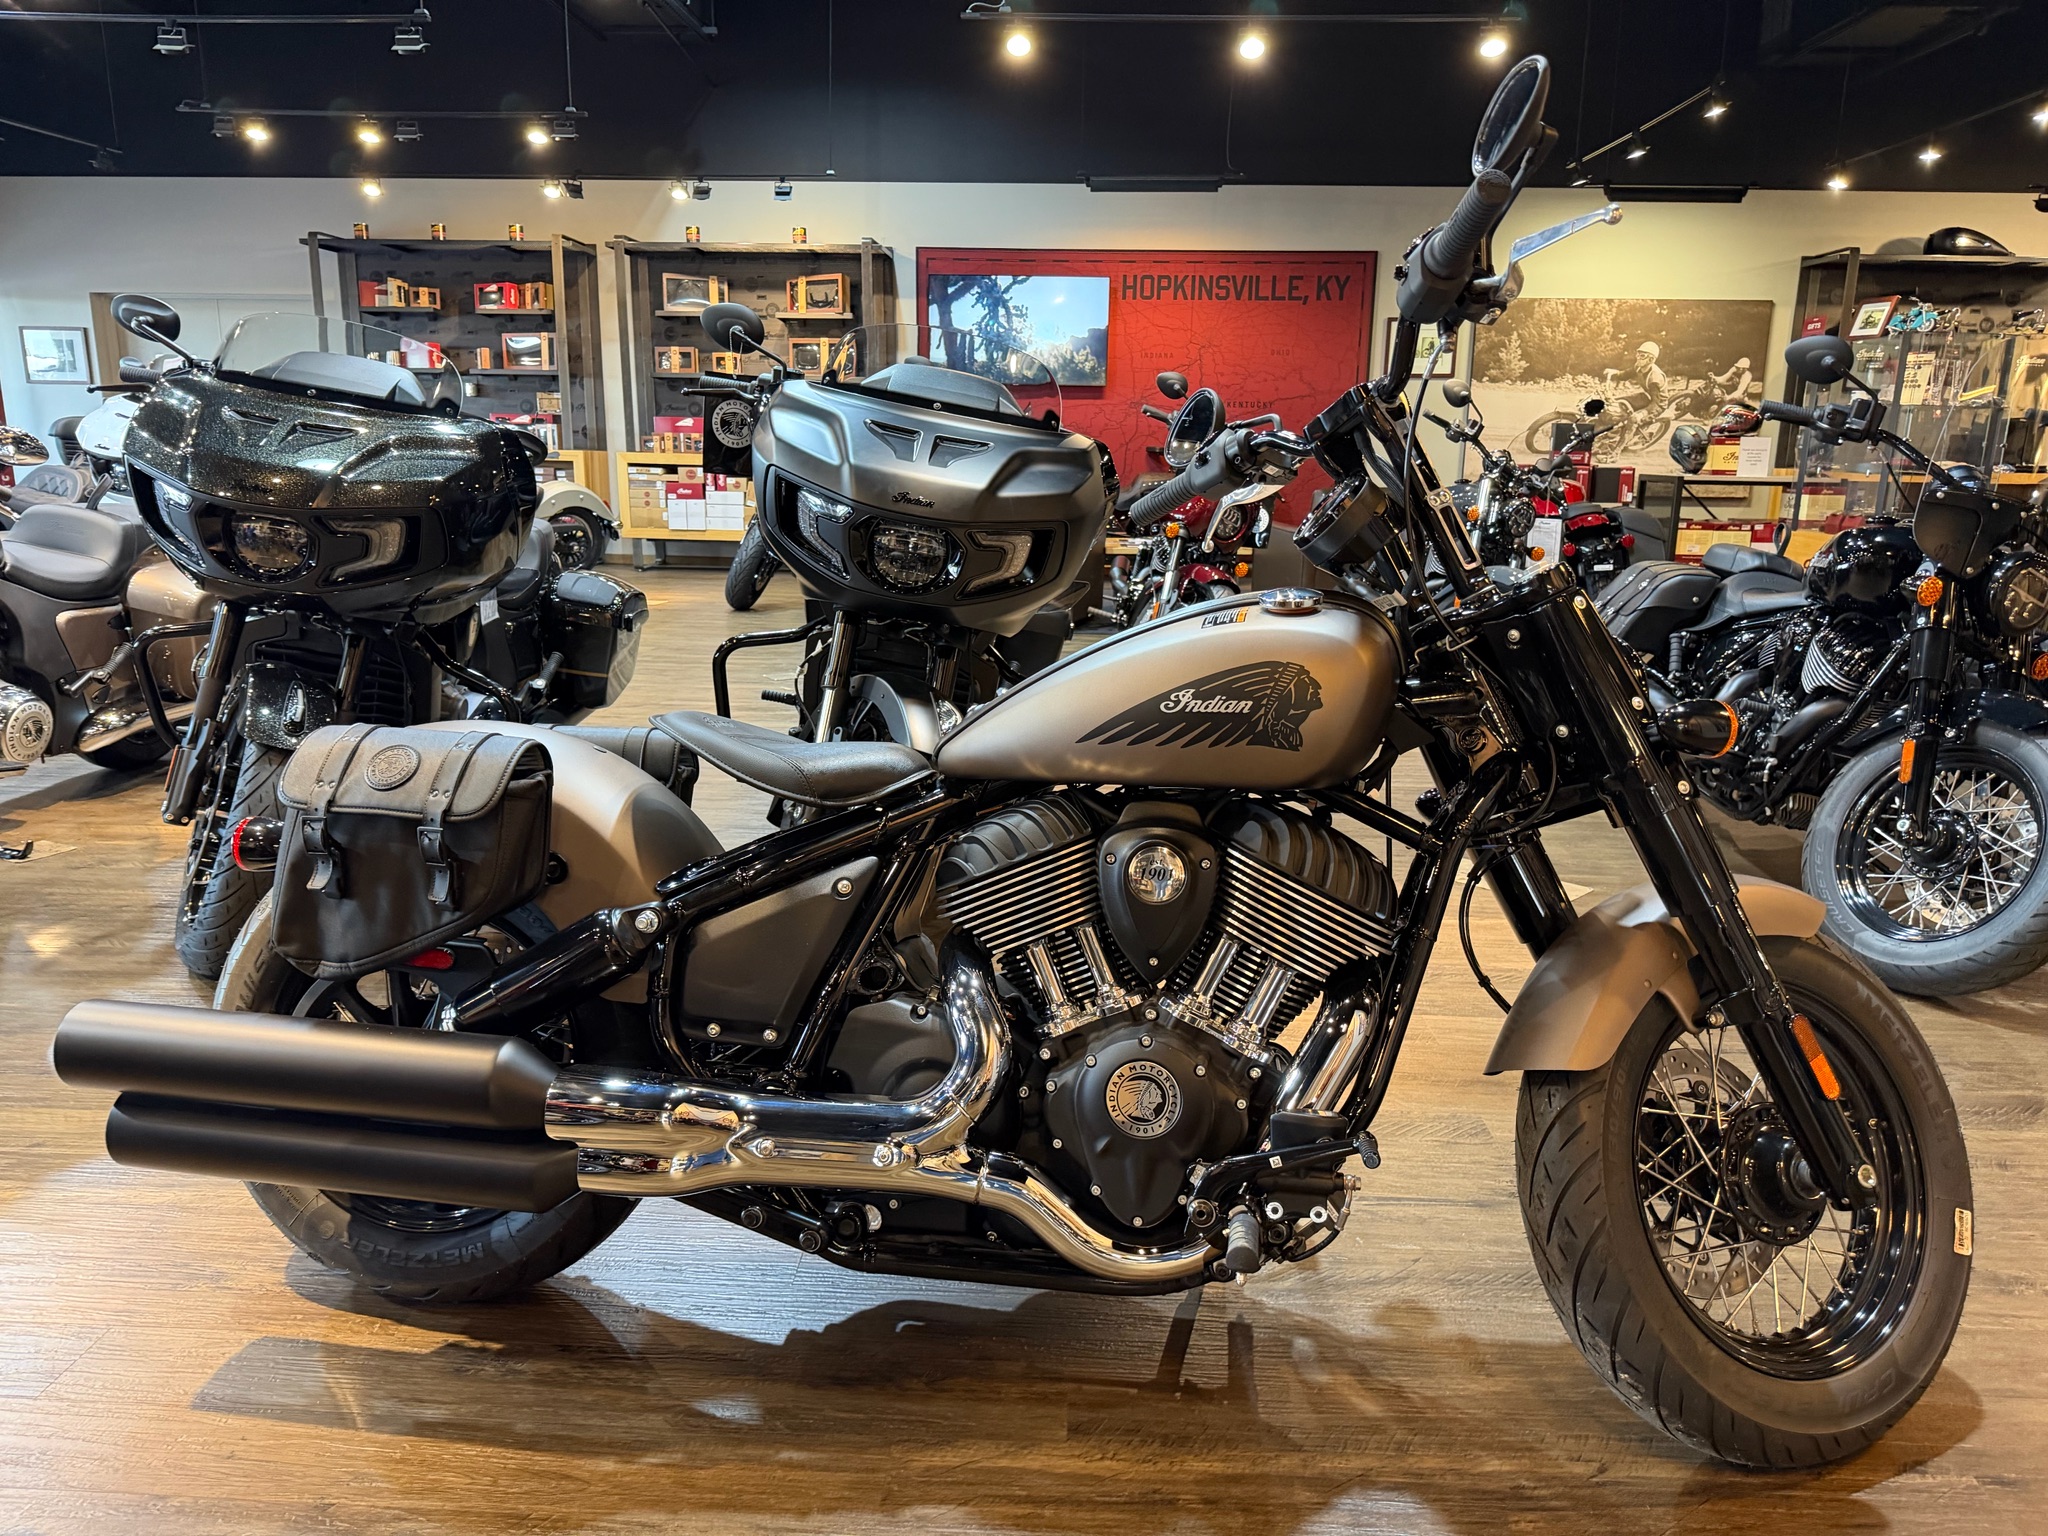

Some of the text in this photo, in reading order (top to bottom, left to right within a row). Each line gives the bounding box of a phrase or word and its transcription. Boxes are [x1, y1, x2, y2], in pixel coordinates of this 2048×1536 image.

[1122, 274, 1351, 305] HOPKINSVILLE, KY
[1140, 351, 1175, 360] INDIANA
[1270, 348, 1291, 357] OHIO
[1226, 400, 1275, 409] KENTUCKY
[713, 405, 724, 437] INDIAN
[891, 491, 936, 509] Indian
[1160, 689, 1253, 713] Indian
[8, 715, 20, 754] INDIAN
[1141, 867, 1174, 881] 1901
[1108, 1064, 1178, 1123] INDIAN MOTORCYCLE
[1129, 1124, 1155, 1134] 1901
[347, 1238, 485, 1269] METZELE
